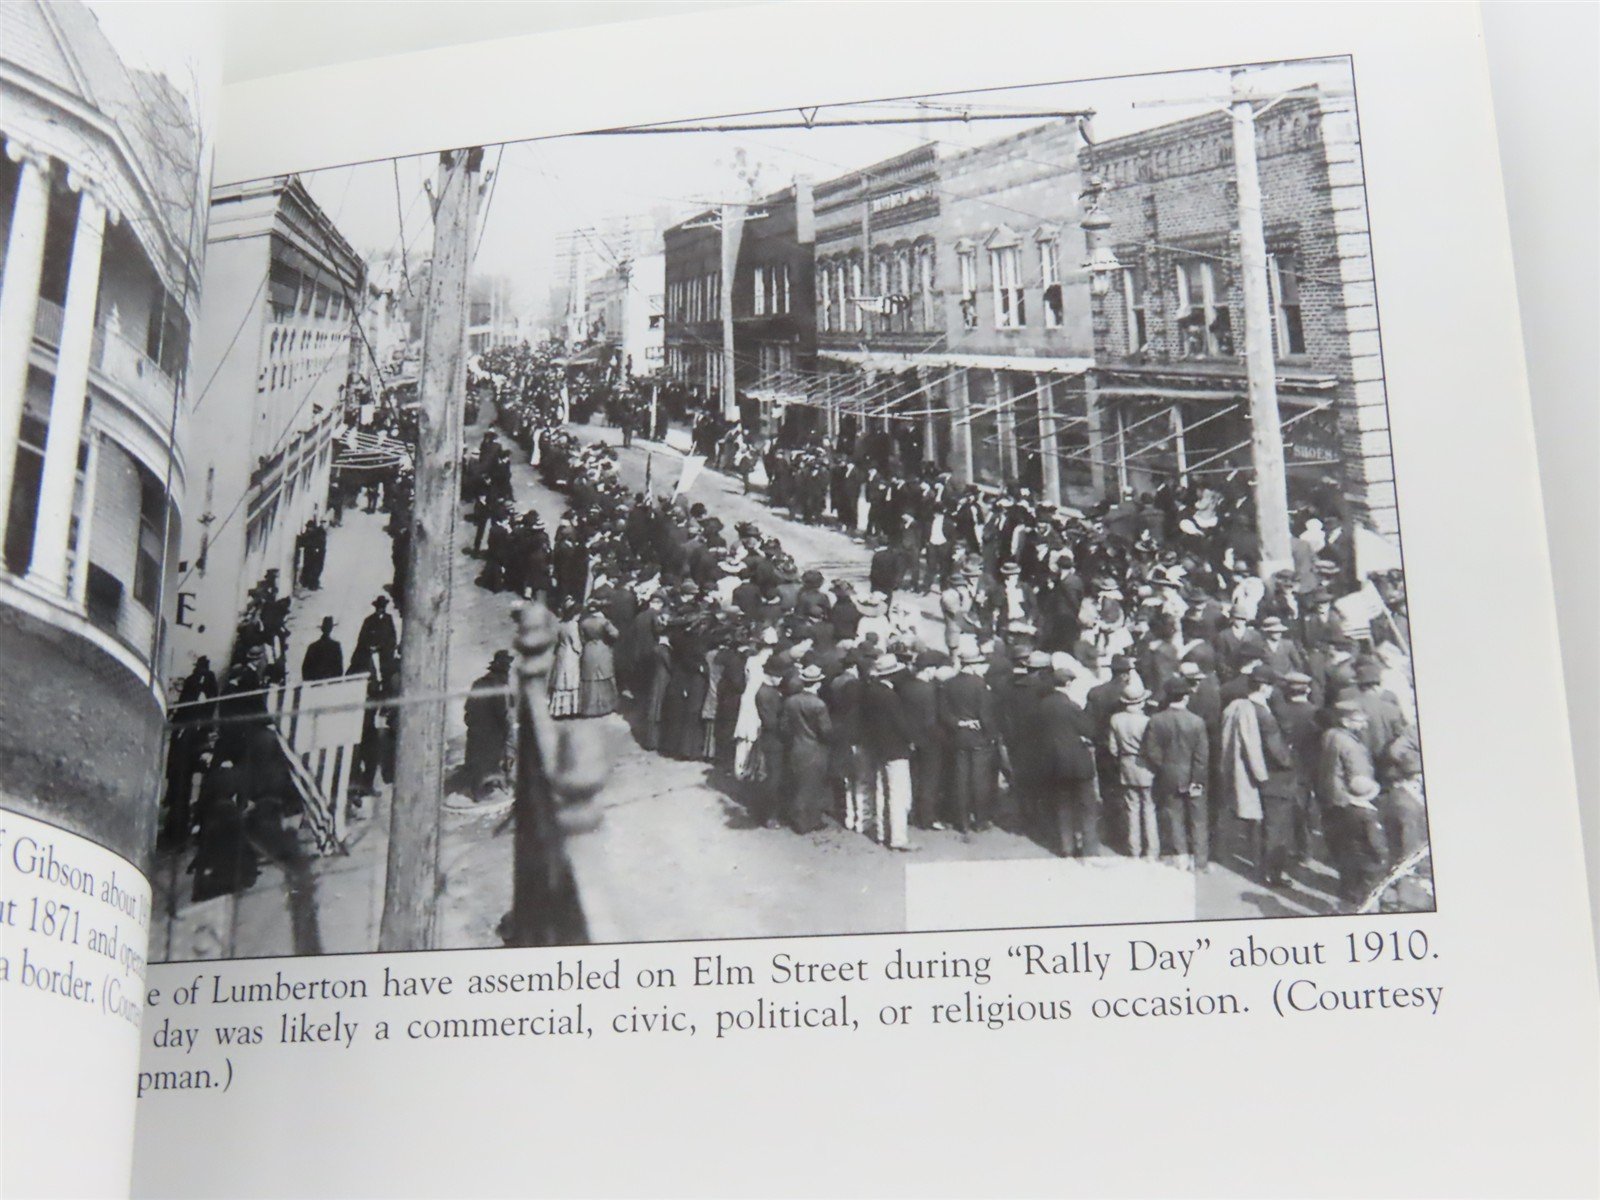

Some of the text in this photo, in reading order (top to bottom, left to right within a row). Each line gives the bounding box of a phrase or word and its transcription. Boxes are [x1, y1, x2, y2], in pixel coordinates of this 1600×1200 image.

[13, 836, 95, 897] Gibson
[101, 871, 137, 919] about
[29, 896, 80, 945] 1871
[88, 925, 118, 960] and
[0, 957, 9, 982] a
[22, 947, 95, 1004] border.
[173, 975, 203, 1006] of
[212, 972, 367, 1004] Lumberton
[383, 967, 452, 997] have
[468, 958, 620, 994] assembled
[637, 969, 676, 989] on
[694, 955, 755, 987] Elm
[772, 954, 868, 984] Street
[885, 948, 991, 986] during
[1230, 935, 1326, 968] about
[1346, 930, 1439, 963] 1910.
[153, 978, 1444, 1054] day was likely a commercial, civic, political, or religious occasion. (Courtesy
